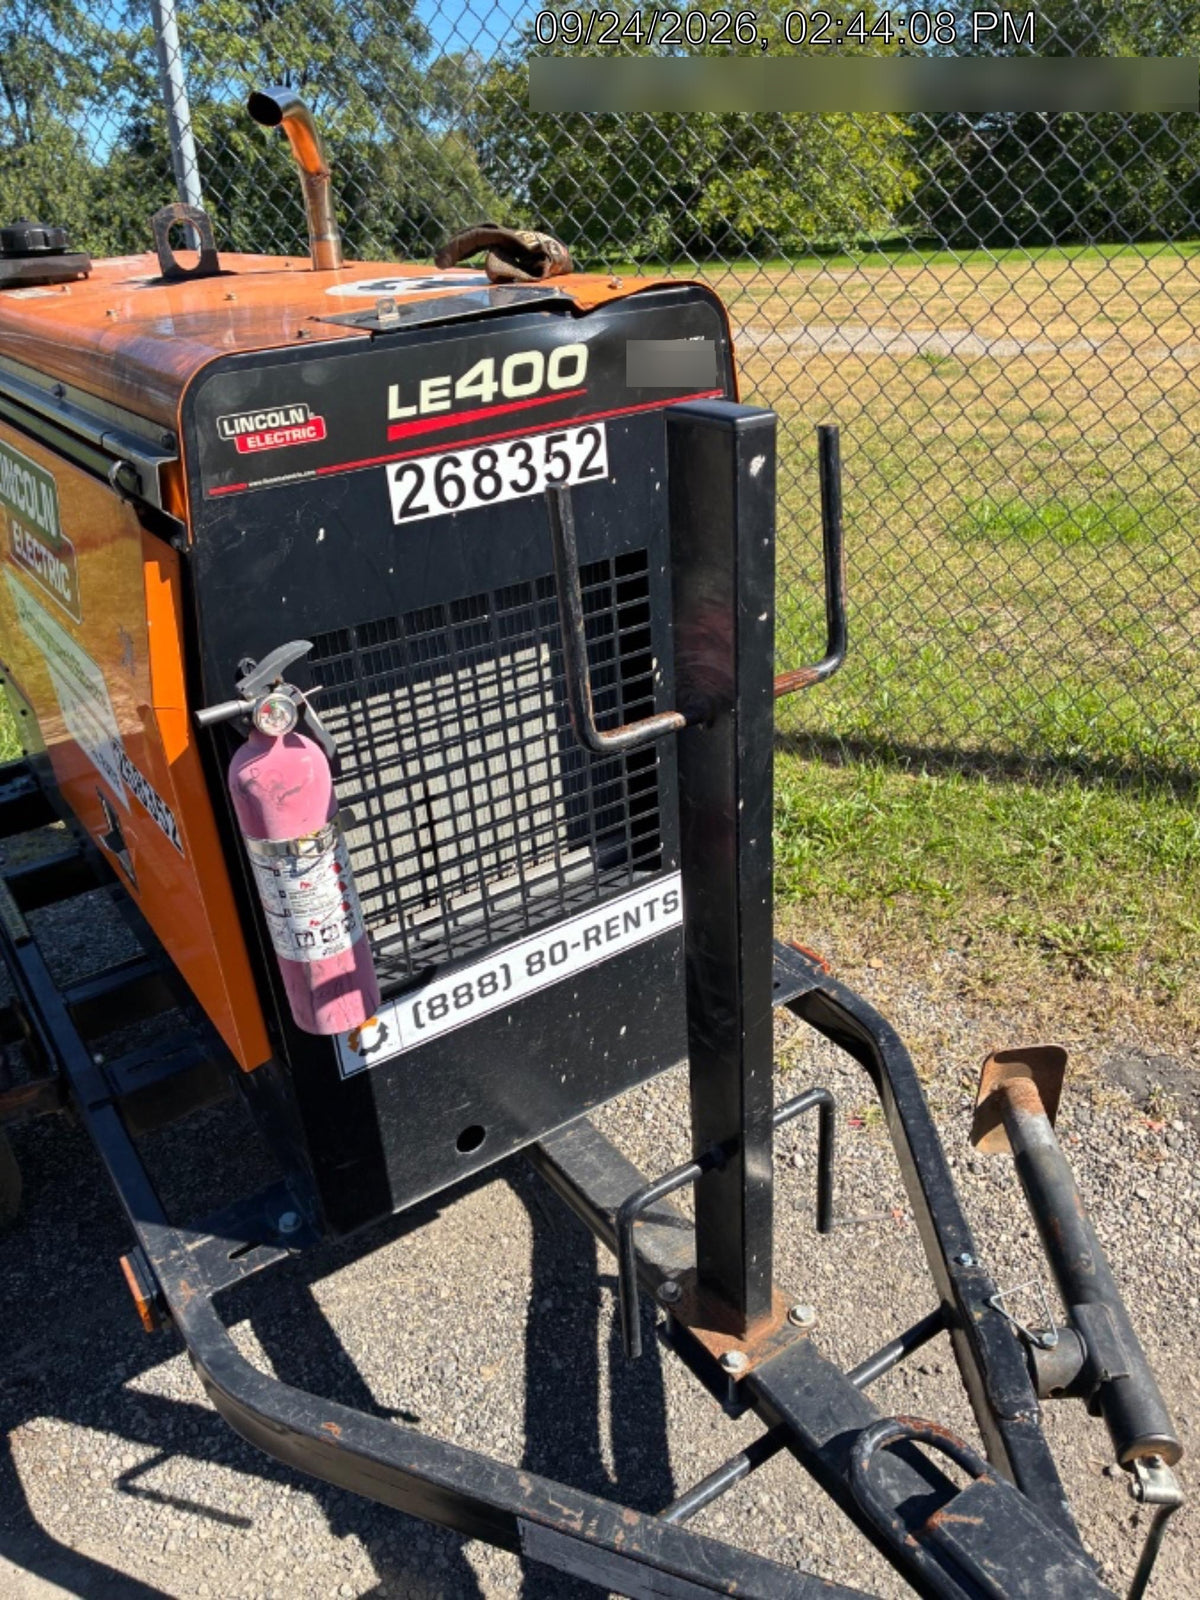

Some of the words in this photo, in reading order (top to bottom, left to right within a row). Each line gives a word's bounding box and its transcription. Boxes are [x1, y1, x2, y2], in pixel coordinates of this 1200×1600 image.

[222, 407, 305, 436] LINCOLN
[387, 342, 590, 421] LE400
[245, 426, 317, 449] ELECTRIC
[393, 425, 605, 520] 268352
[0, 451, 58, 539] INCOLN
[12, 519, 72, 603] ELECTRIC
[412, 962, 513, 1029] (888)
[525, 888, 680, 977] 80-RENTS
